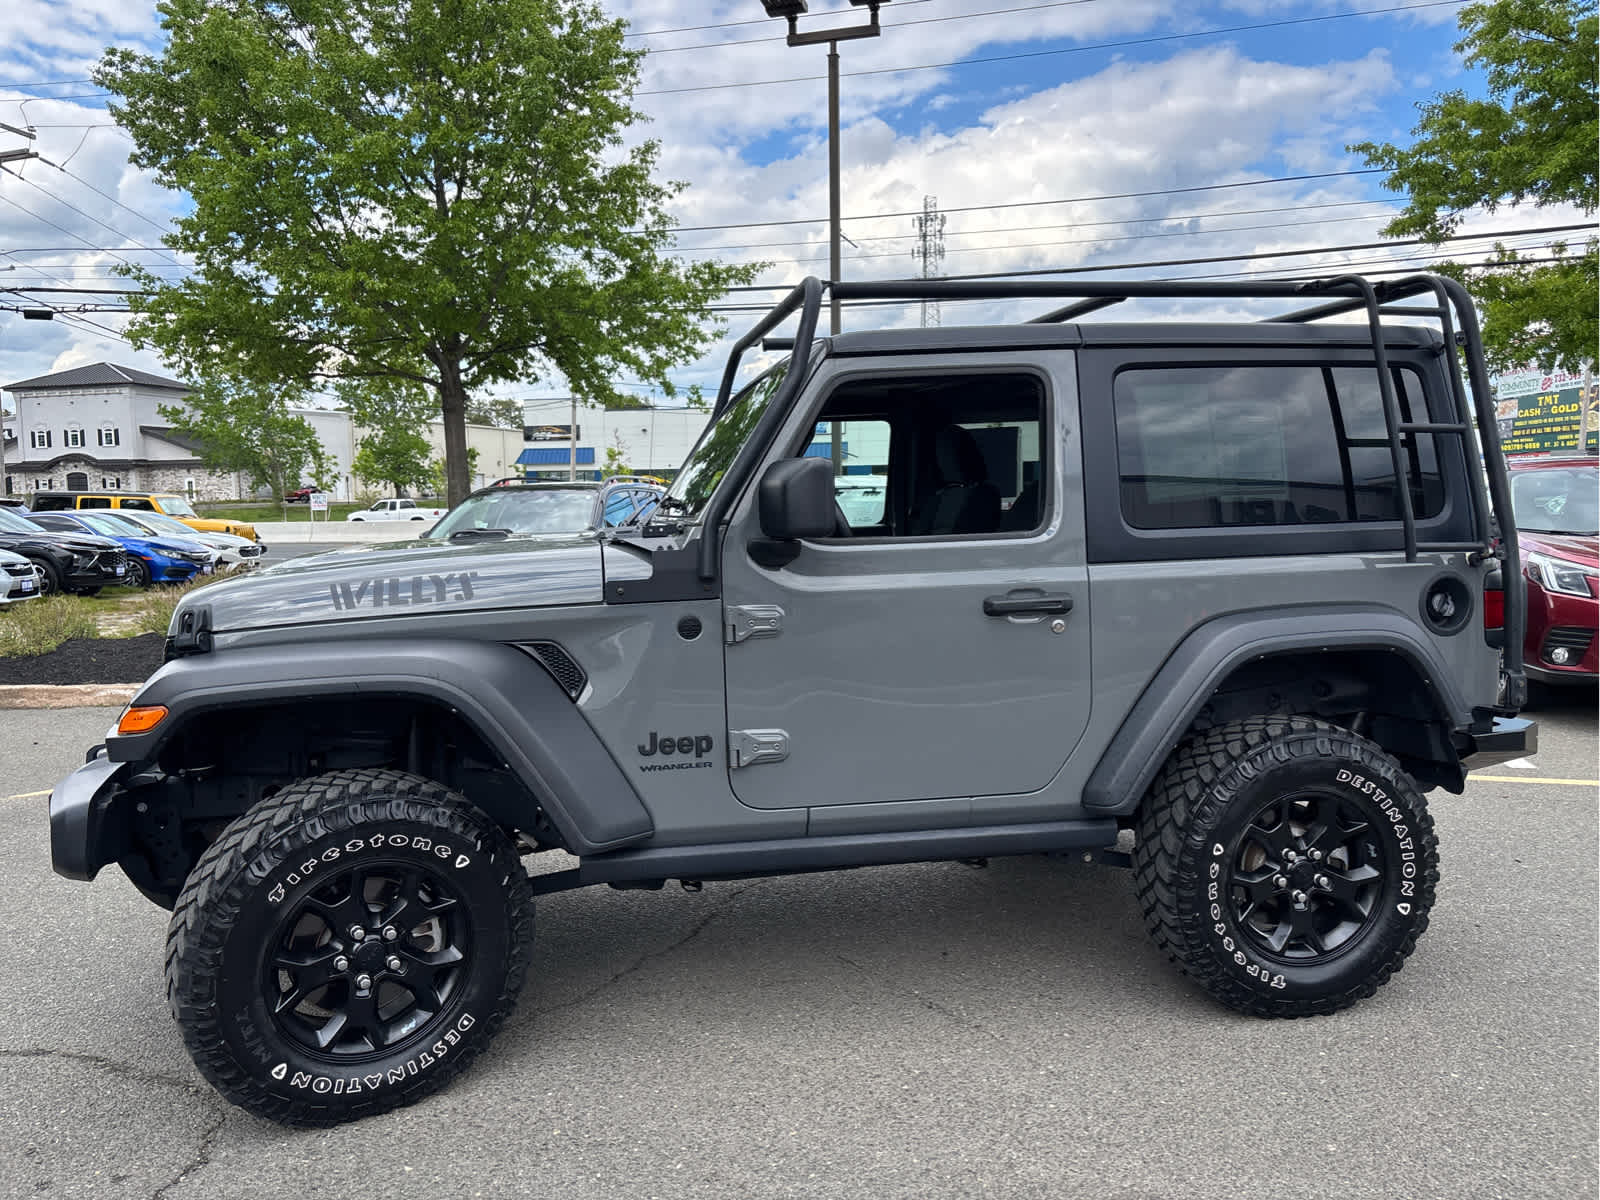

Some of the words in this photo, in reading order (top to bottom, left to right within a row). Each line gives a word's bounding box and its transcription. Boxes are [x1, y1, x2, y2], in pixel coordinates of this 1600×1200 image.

[1518, 408, 1541, 418] CASH
[1551, 403, 1579, 414] GOLD
[1537, 394, 1560, 406] TMT
[330, 571, 478, 611] WILLYS
[637, 731, 713, 758] Jeep
[640, 761, 713, 772] WRANGLER
[1336, 769, 1416, 896] DESTINATION
[290, 1013, 475, 1095] DESTINATION
